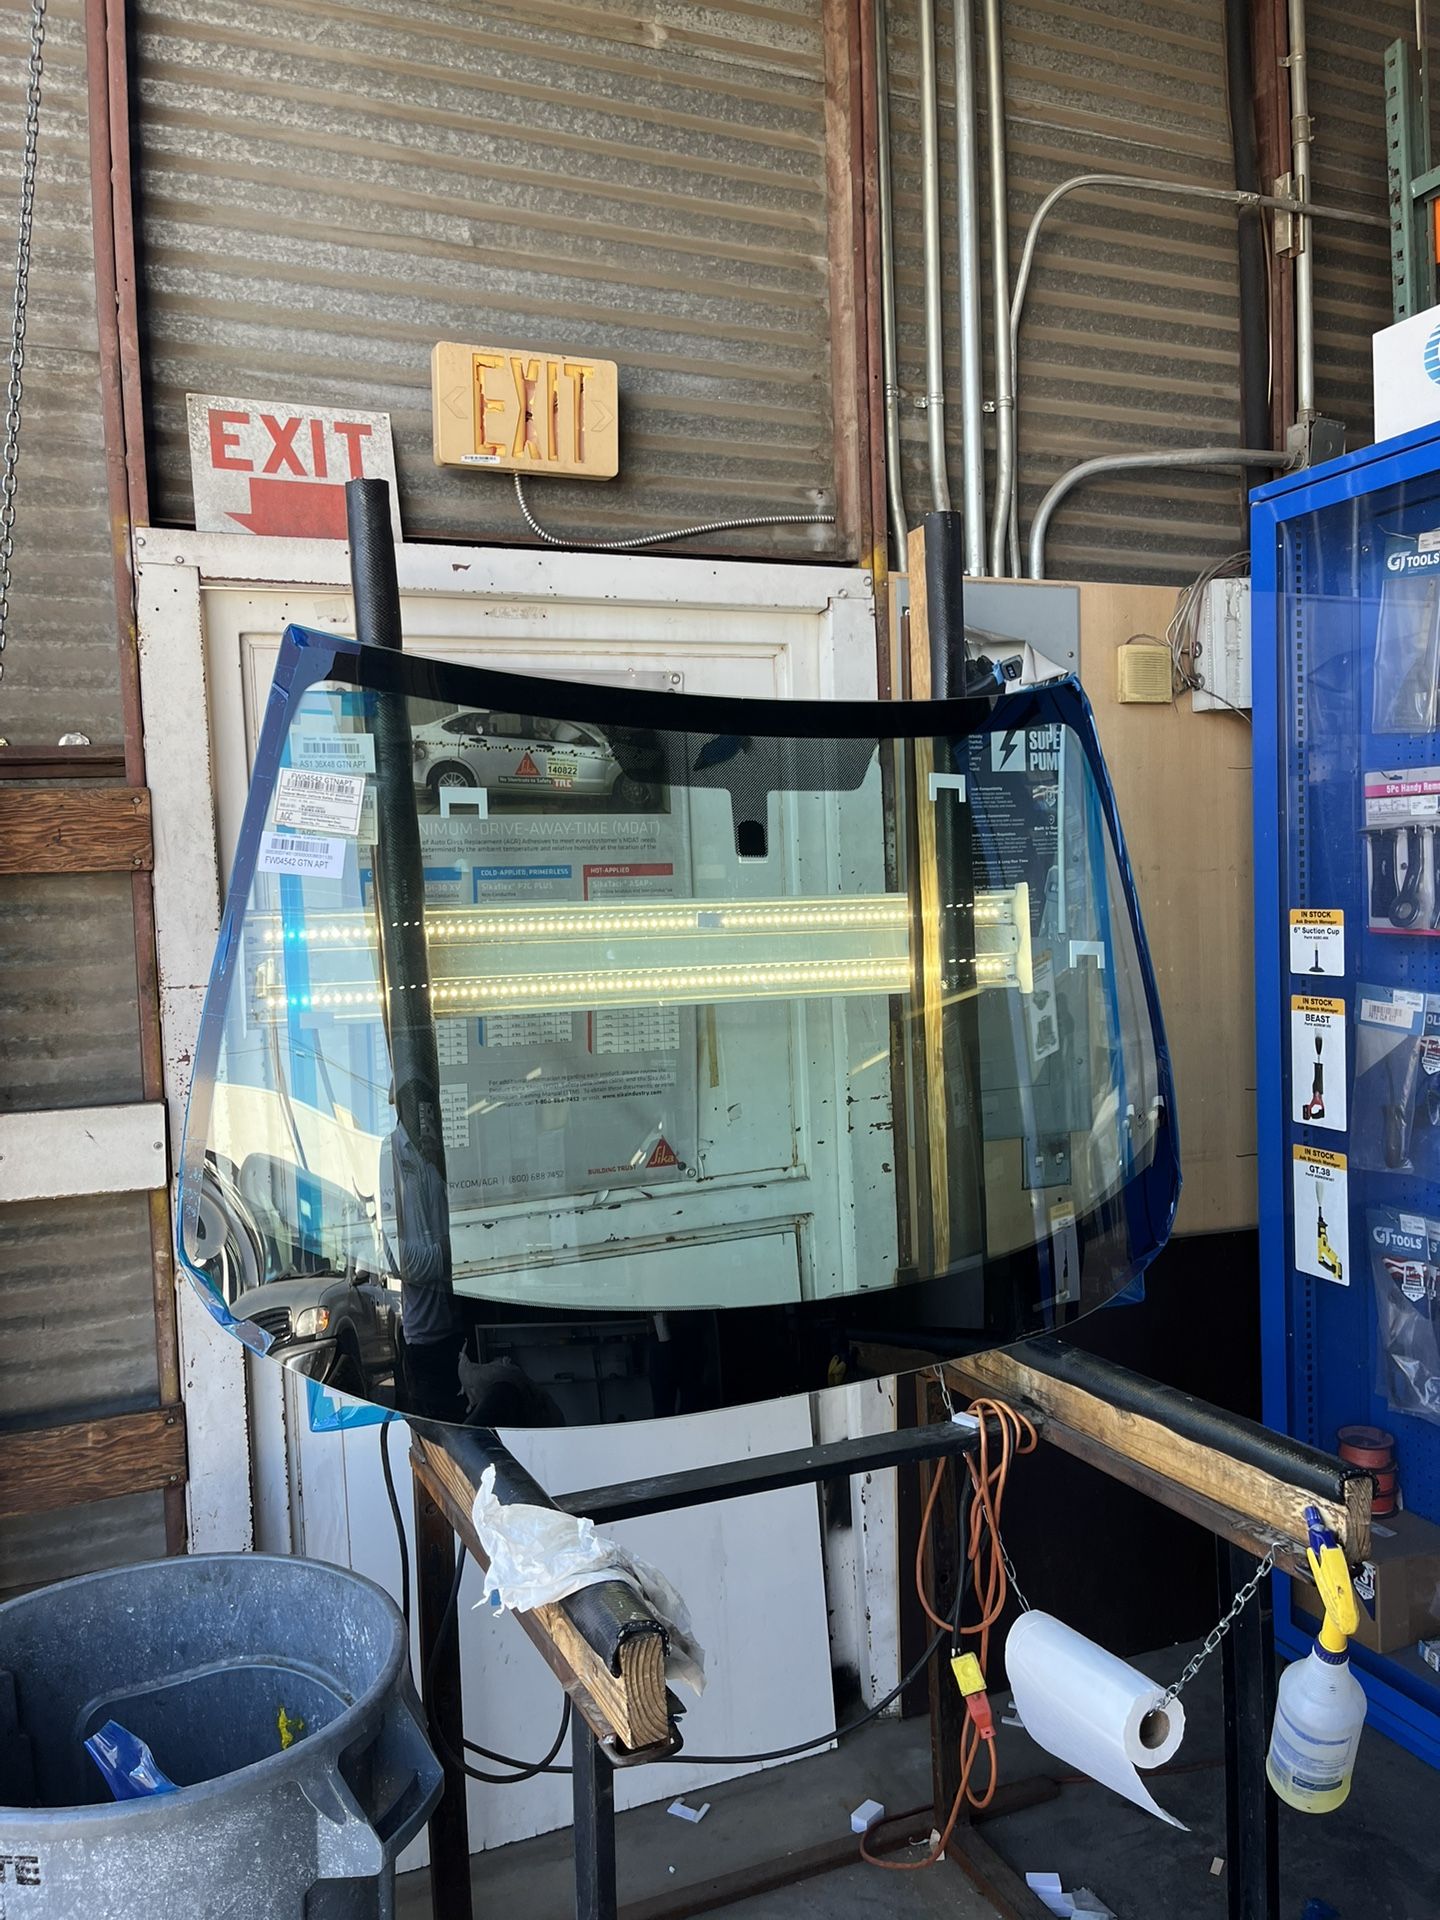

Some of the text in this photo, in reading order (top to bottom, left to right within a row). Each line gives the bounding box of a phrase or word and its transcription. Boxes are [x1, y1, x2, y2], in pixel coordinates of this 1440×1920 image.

[472, 353, 594, 463] EXIT
[208, 409, 373, 479] EXIT
[1407, 553, 1440, 568] TOOLS
[1029, 731, 1060, 750] SUPE
[353, 760, 367, 768] APT
[1030, 752, 1059, 771] PUM
[548, 766, 578, 775] 140822
[419, 819, 660, 836] NIMUM-DRIVE-AWAY-TIME (MDAT)
[265, 855, 329, 869] FW04542 GTN APT
[529, 868, 569, 876] PRIMERLESS
[1302, 926, 1326, 934] Suction
[1326, 927, 1340, 936] Cup
[1311, 998, 1333, 1007] STOCK
[1305, 1013, 1330, 1024] BEAST
[1312, 1149, 1335, 1160] STOCK
[587, 1164, 637, 1175] BUILDING TRUST
[1309, 1164, 1331, 1177] GT.38
[448, 1176, 499, 1190] RY.COM/AGR
[508, 1173, 529, 1184] (800)
[1391, 1234, 1422, 1250] TOOLS
[0, 1855, 41, 1885] TE
